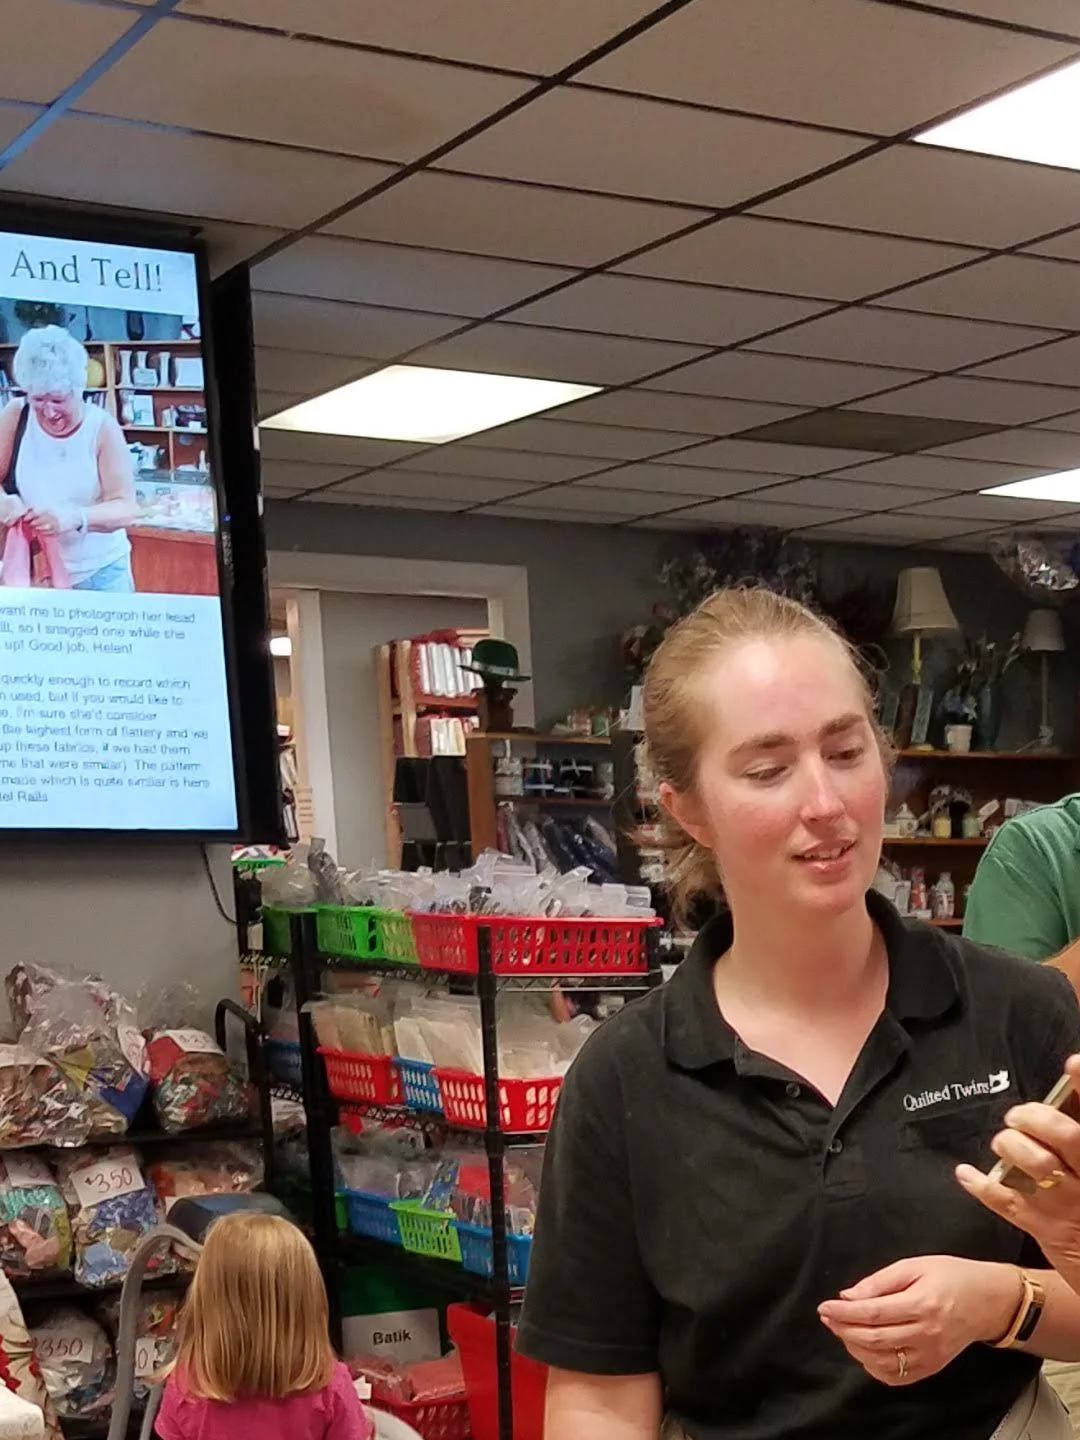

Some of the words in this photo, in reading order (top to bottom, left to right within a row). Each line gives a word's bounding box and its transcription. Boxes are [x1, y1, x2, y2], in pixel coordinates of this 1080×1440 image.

[11, 250, 80, 284] And
[91, 258, 162, 292] Tell!
[53, 607, 65, 618] to
[69, 608, 139, 622] photograph
[28, 639, 63, 652] Good
[903, 1085, 951, 1111] Quilted
[951, 1079, 990, 1100] Twins
[372, 1328, 412, 1346] Batik
